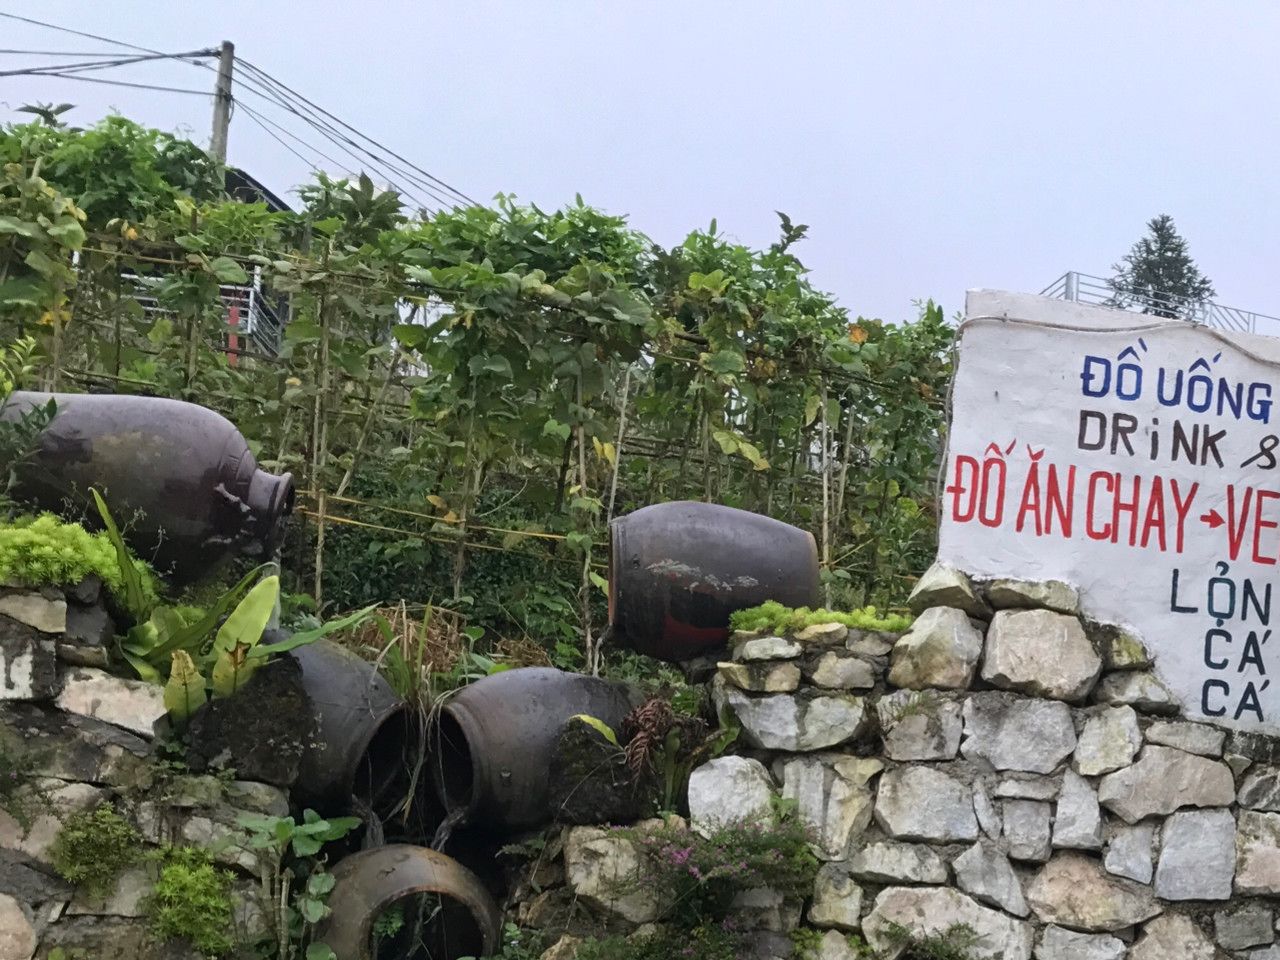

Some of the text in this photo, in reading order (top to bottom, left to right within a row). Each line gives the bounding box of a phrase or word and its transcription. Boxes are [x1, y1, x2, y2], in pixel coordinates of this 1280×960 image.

[1080, 338, 1148, 401] ĐỒ
[1157, 352, 1273, 424] UỐNG
[1240, 434, 1280, 470] &
[1015, 444, 1076, 538] ĂN
[1086, 471, 1199, 553] CHAY
[1204, 628, 1272, 675] CÁ
[1201, 678, 1270, 722] CÁ
